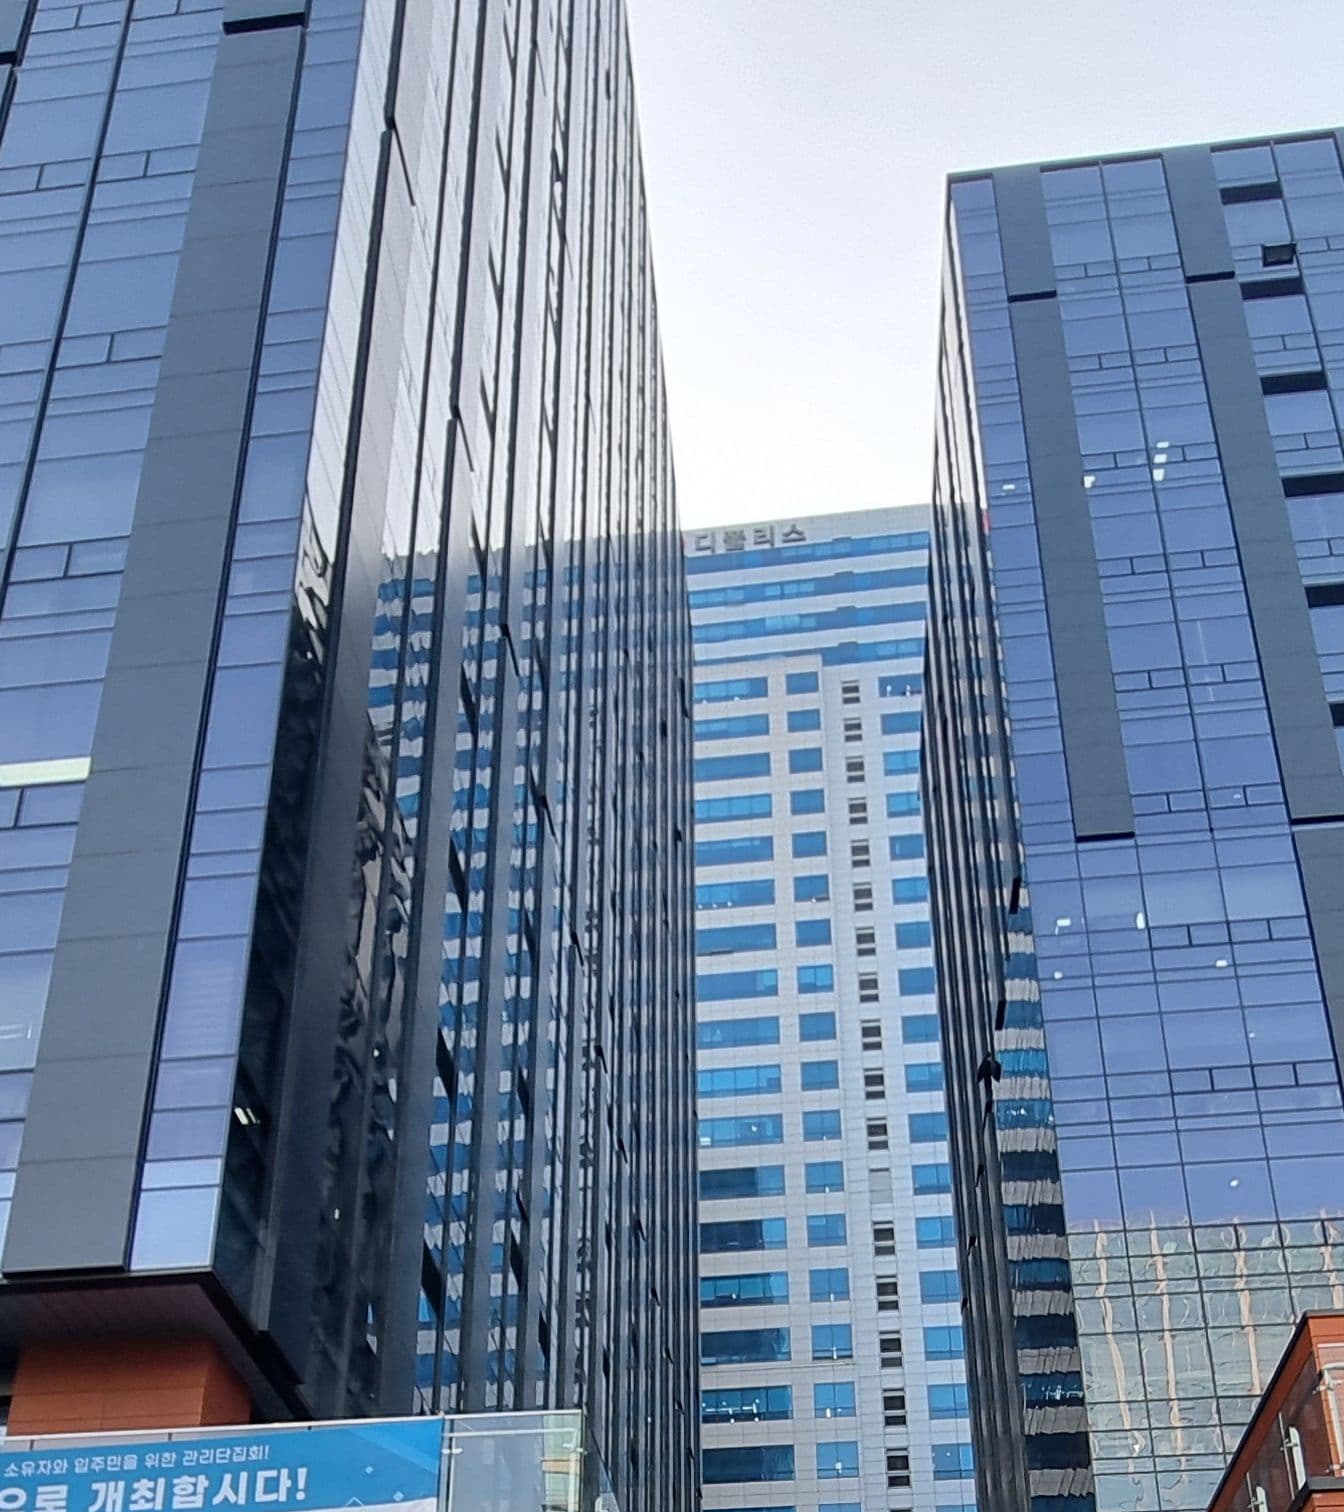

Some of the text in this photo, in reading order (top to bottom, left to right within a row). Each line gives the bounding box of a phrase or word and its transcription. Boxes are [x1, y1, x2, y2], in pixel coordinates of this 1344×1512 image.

[4, 1460, 69, 1480] 소유자와
[74, 1454, 138, 1475] 입주민을
[144, 1450, 176, 1469] 위한
[182, 1444, 271, 1466] 관리단집회!
